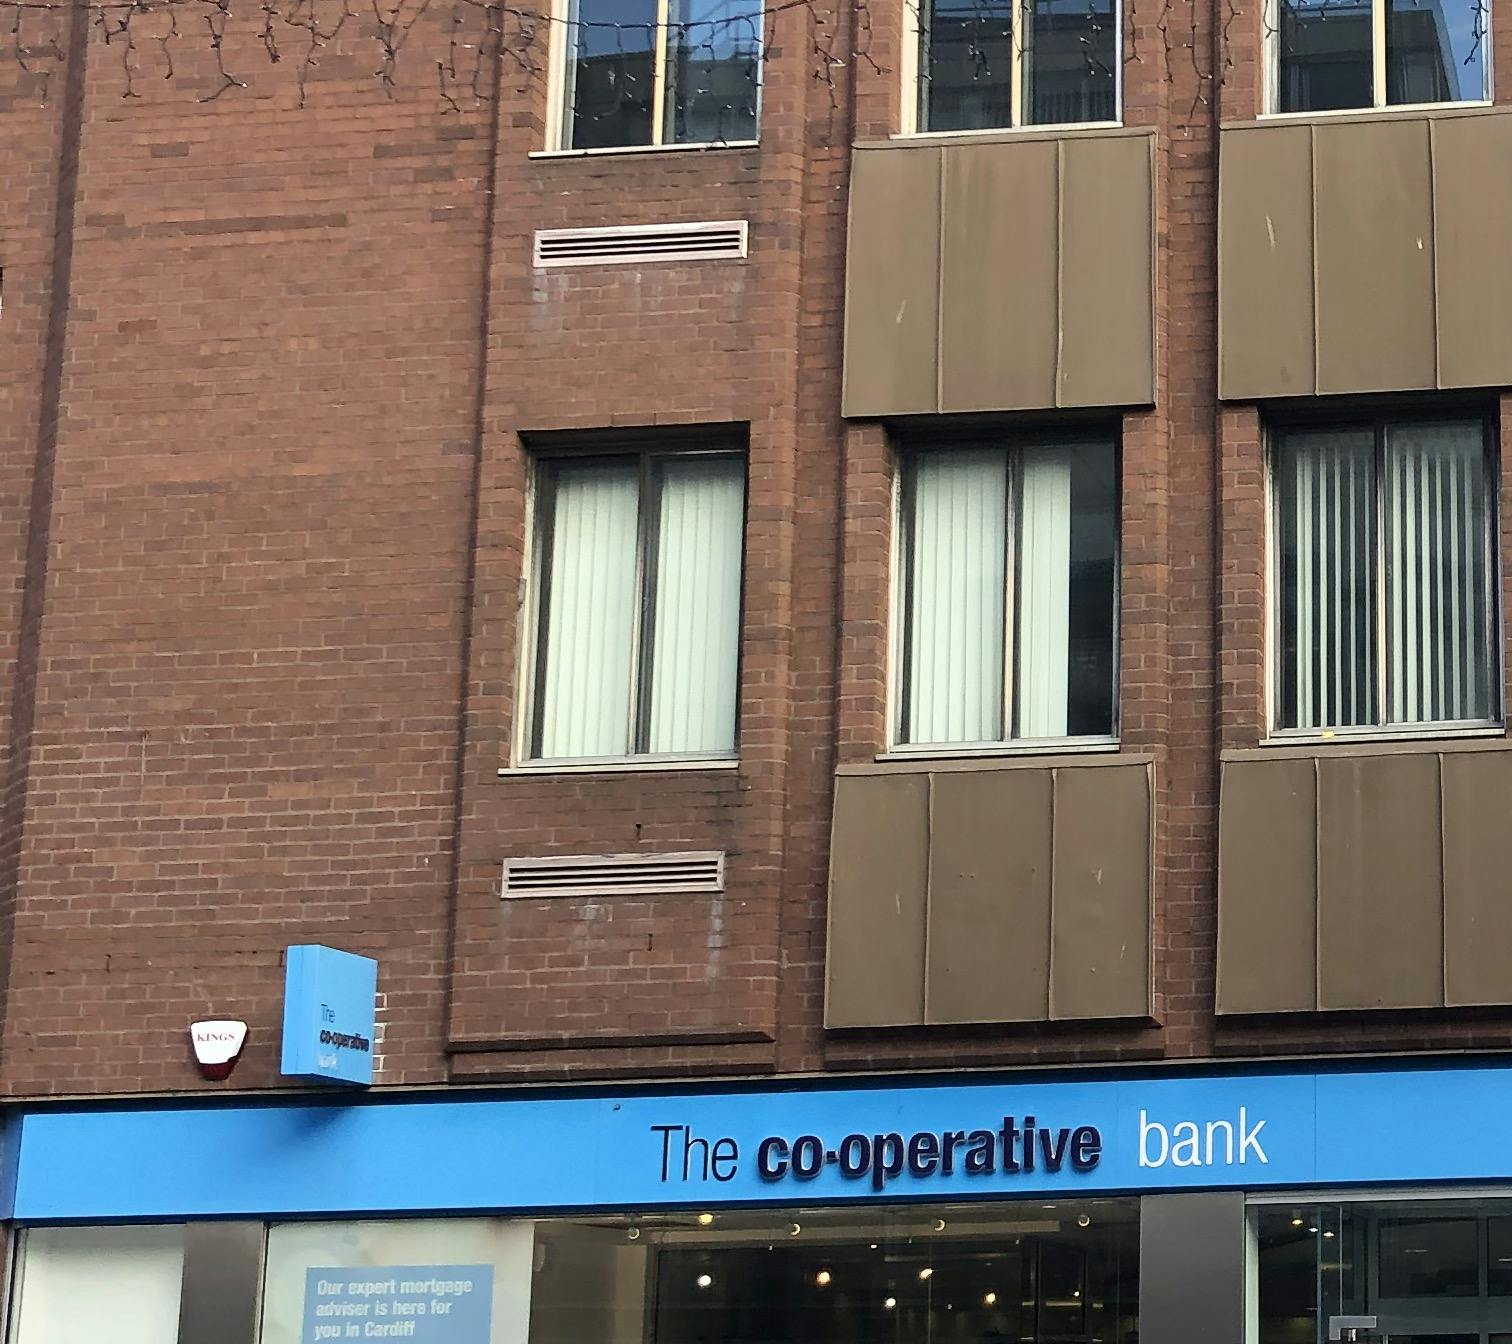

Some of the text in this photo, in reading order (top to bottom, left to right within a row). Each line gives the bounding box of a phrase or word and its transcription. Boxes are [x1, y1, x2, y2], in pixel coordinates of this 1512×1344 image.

[196, 1032, 236, 1042] KINGS
[320, 1029, 370, 1053] co-operative
[650, 1106, 1271, 1192] The co-operative bank
[316, 1278, 473, 1298] Our expert mortgage
[315, 1299, 453, 1316] adviser is here for
[314, 1320, 416, 1341] you in Cardiff
